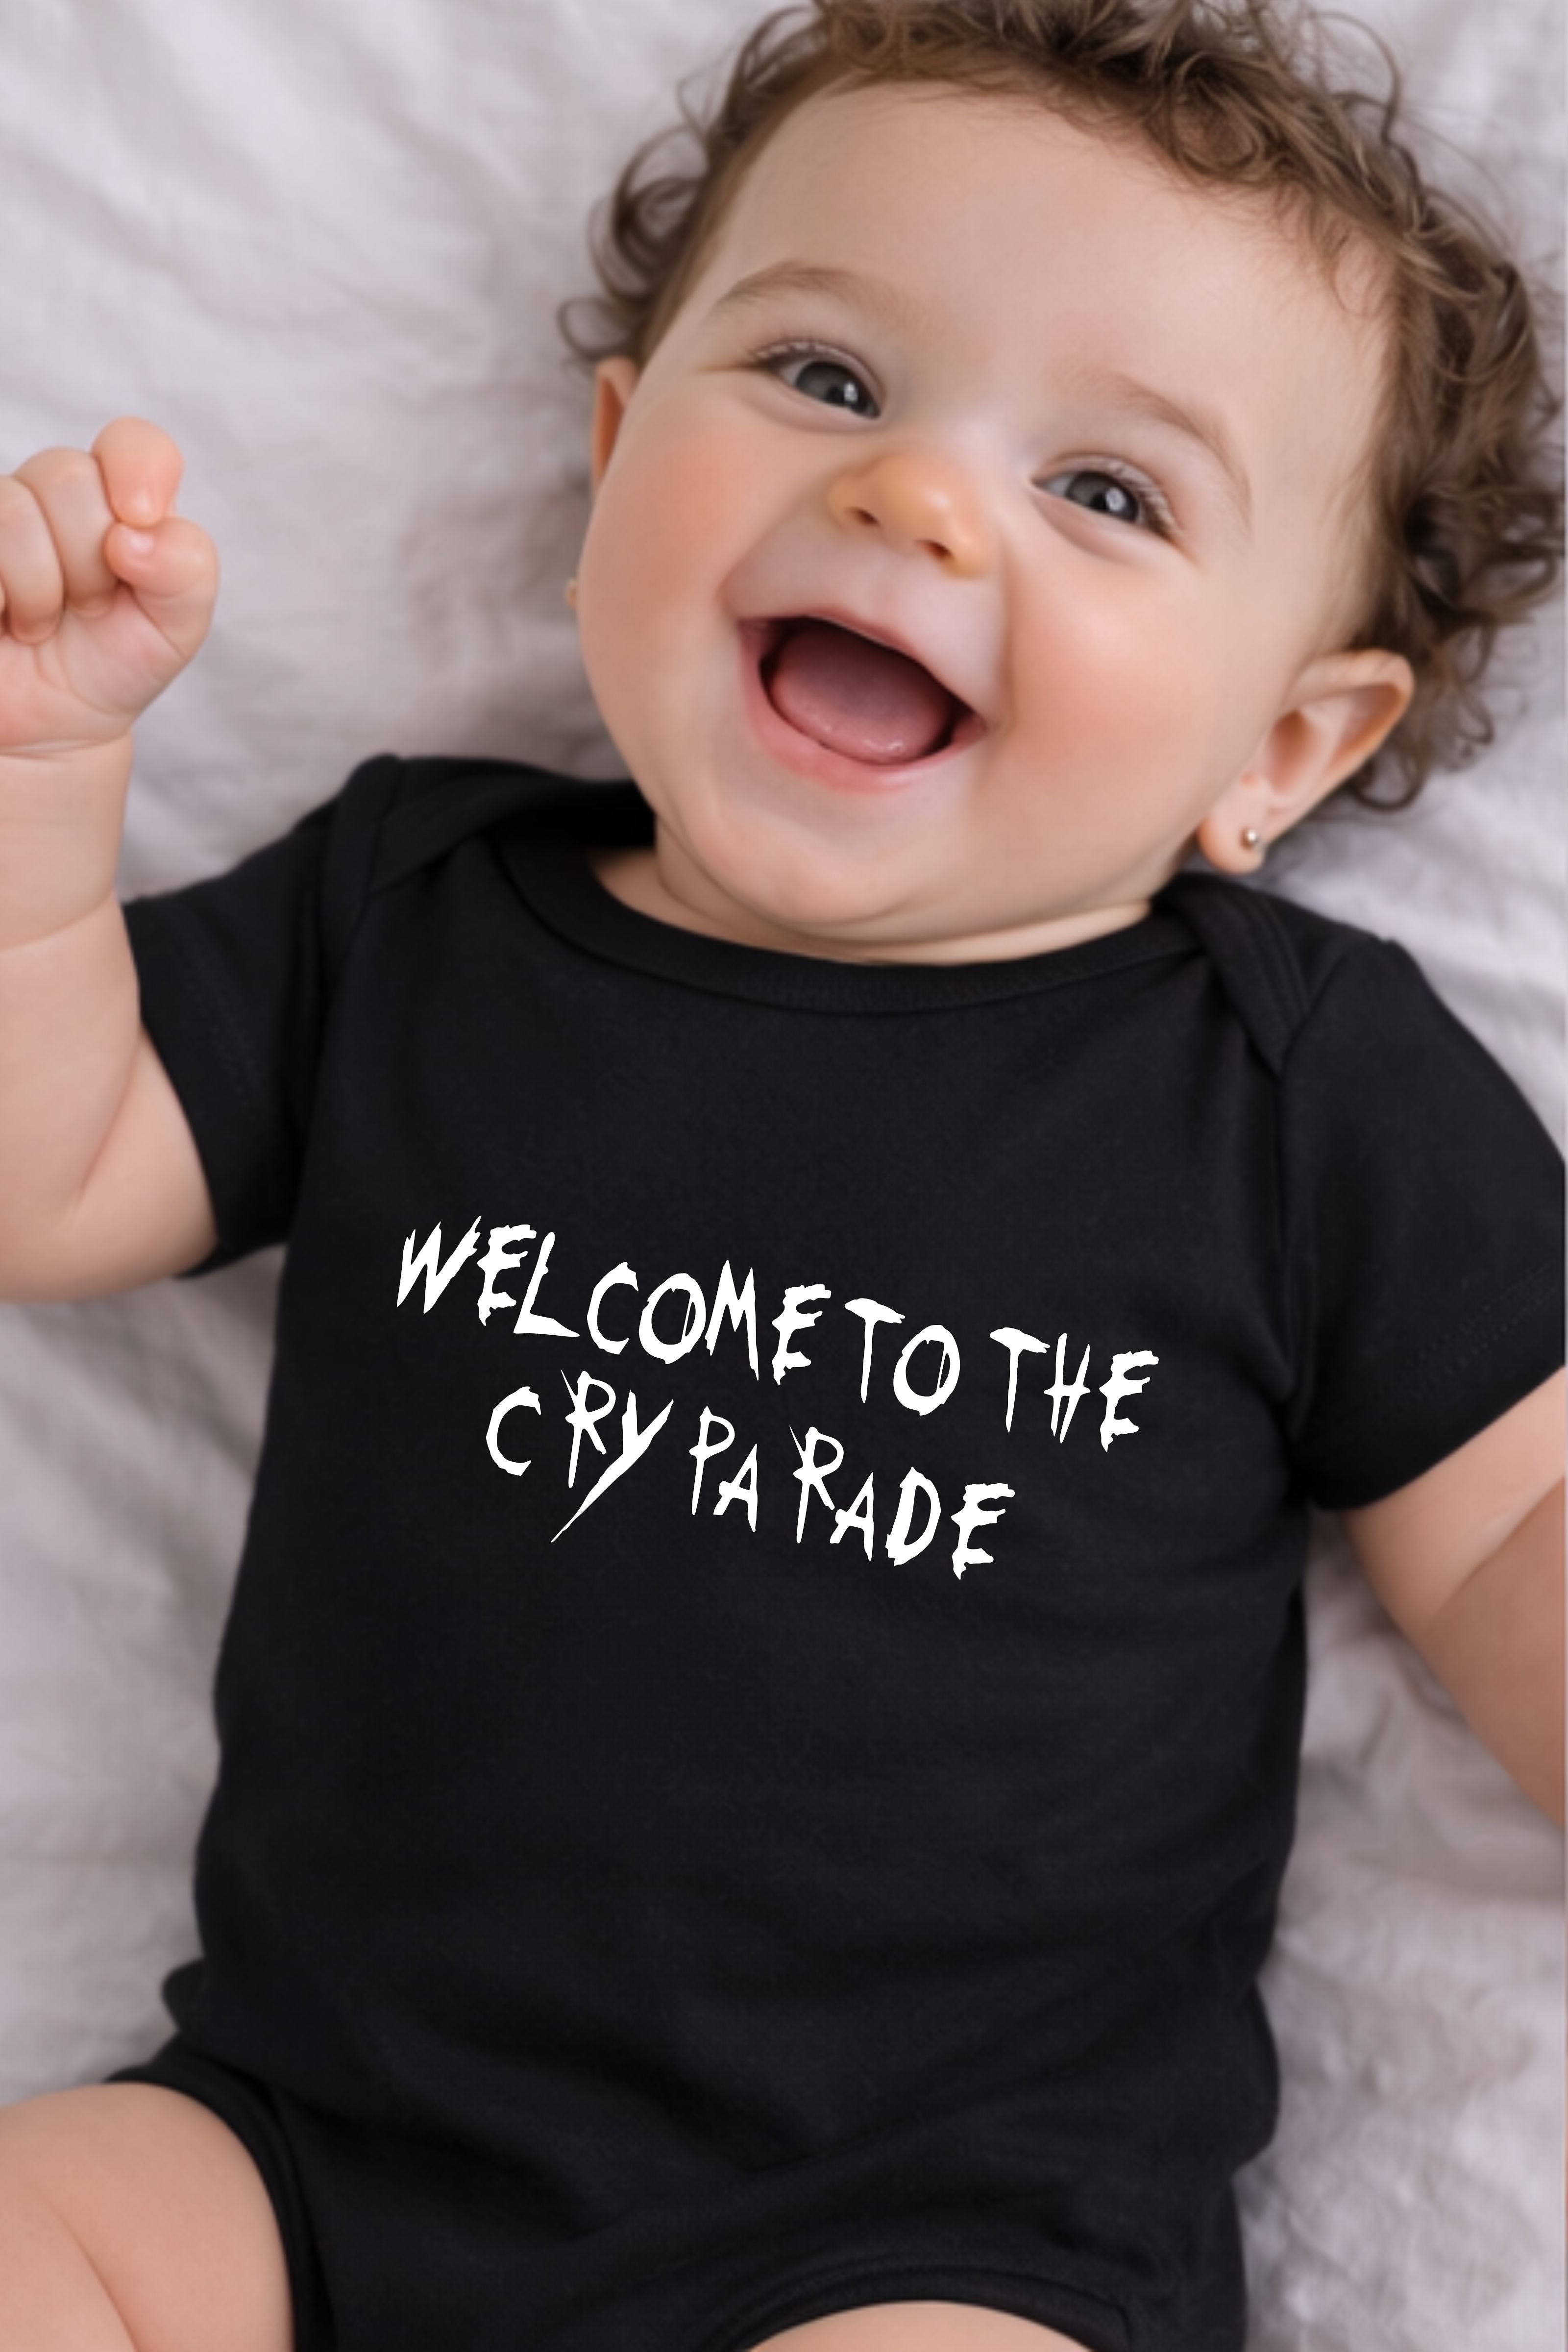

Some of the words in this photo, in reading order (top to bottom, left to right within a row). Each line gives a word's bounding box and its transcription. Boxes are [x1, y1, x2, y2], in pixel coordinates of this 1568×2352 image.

[397, 1216, 831, 1385] WELCOME
[845, 1298, 960, 1416] TO
[990, 1327, 1159, 1452] THE
[486, 1370, 674, 1543] CRY
[689, 1406, 1015, 1580] PARADE
